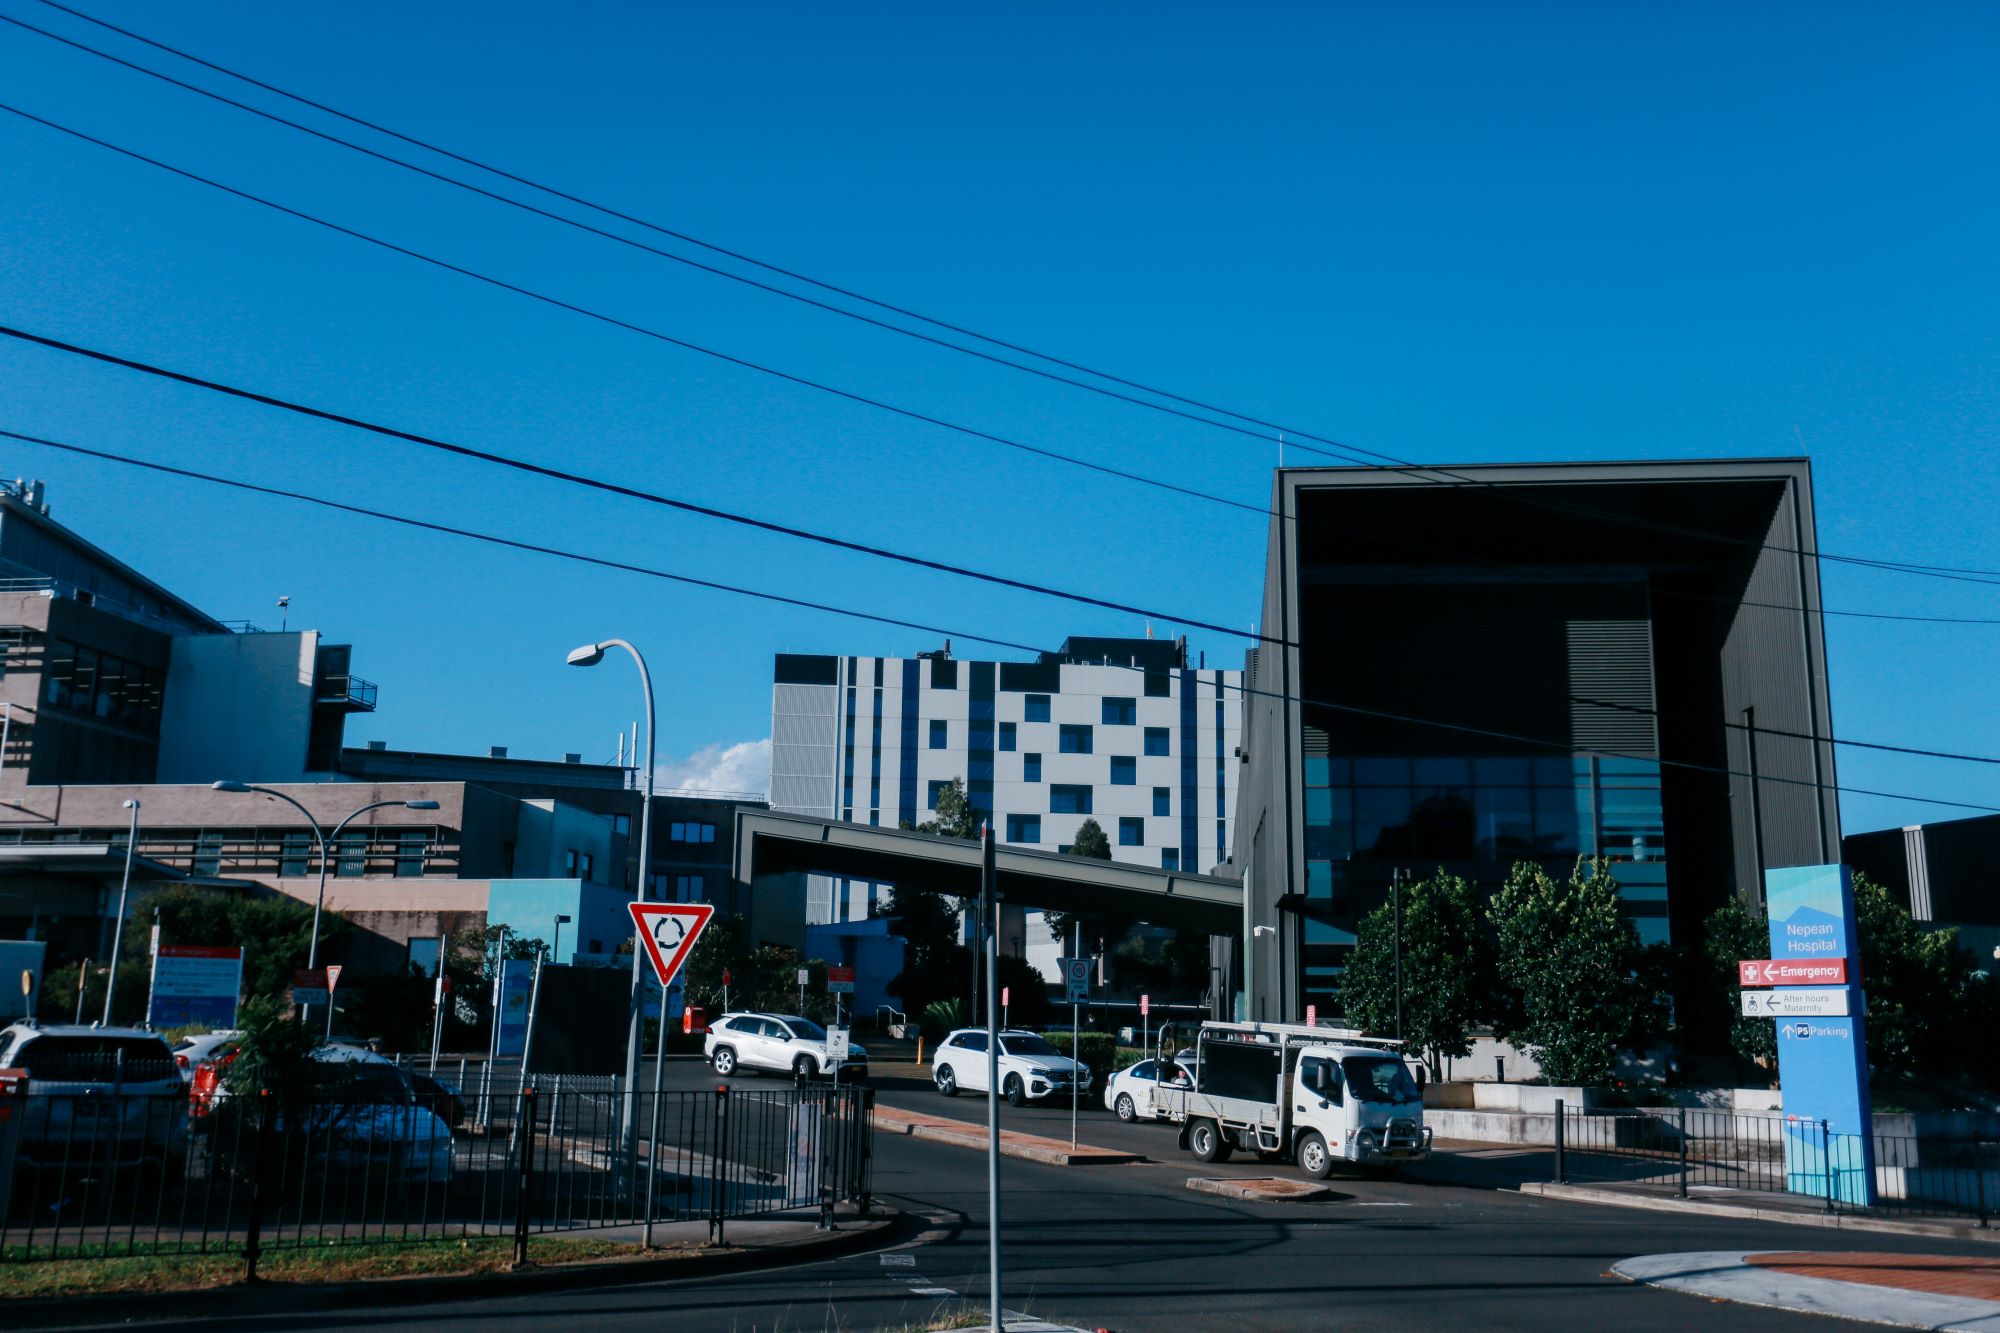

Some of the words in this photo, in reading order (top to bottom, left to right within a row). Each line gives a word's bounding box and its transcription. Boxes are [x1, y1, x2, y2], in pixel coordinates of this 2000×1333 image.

[1787, 924, 1833, 938] Nepean
[1788, 939, 1836, 953] Hospital
[1780, 966, 1840, 978] Emergency
[1784, 994, 1803, 1002] After
[1805, 993, 1829, 1002] hours
[1784, 1004, 1822, 1013] Maternity
[1810, 1026, 1848, 1039] Parking
